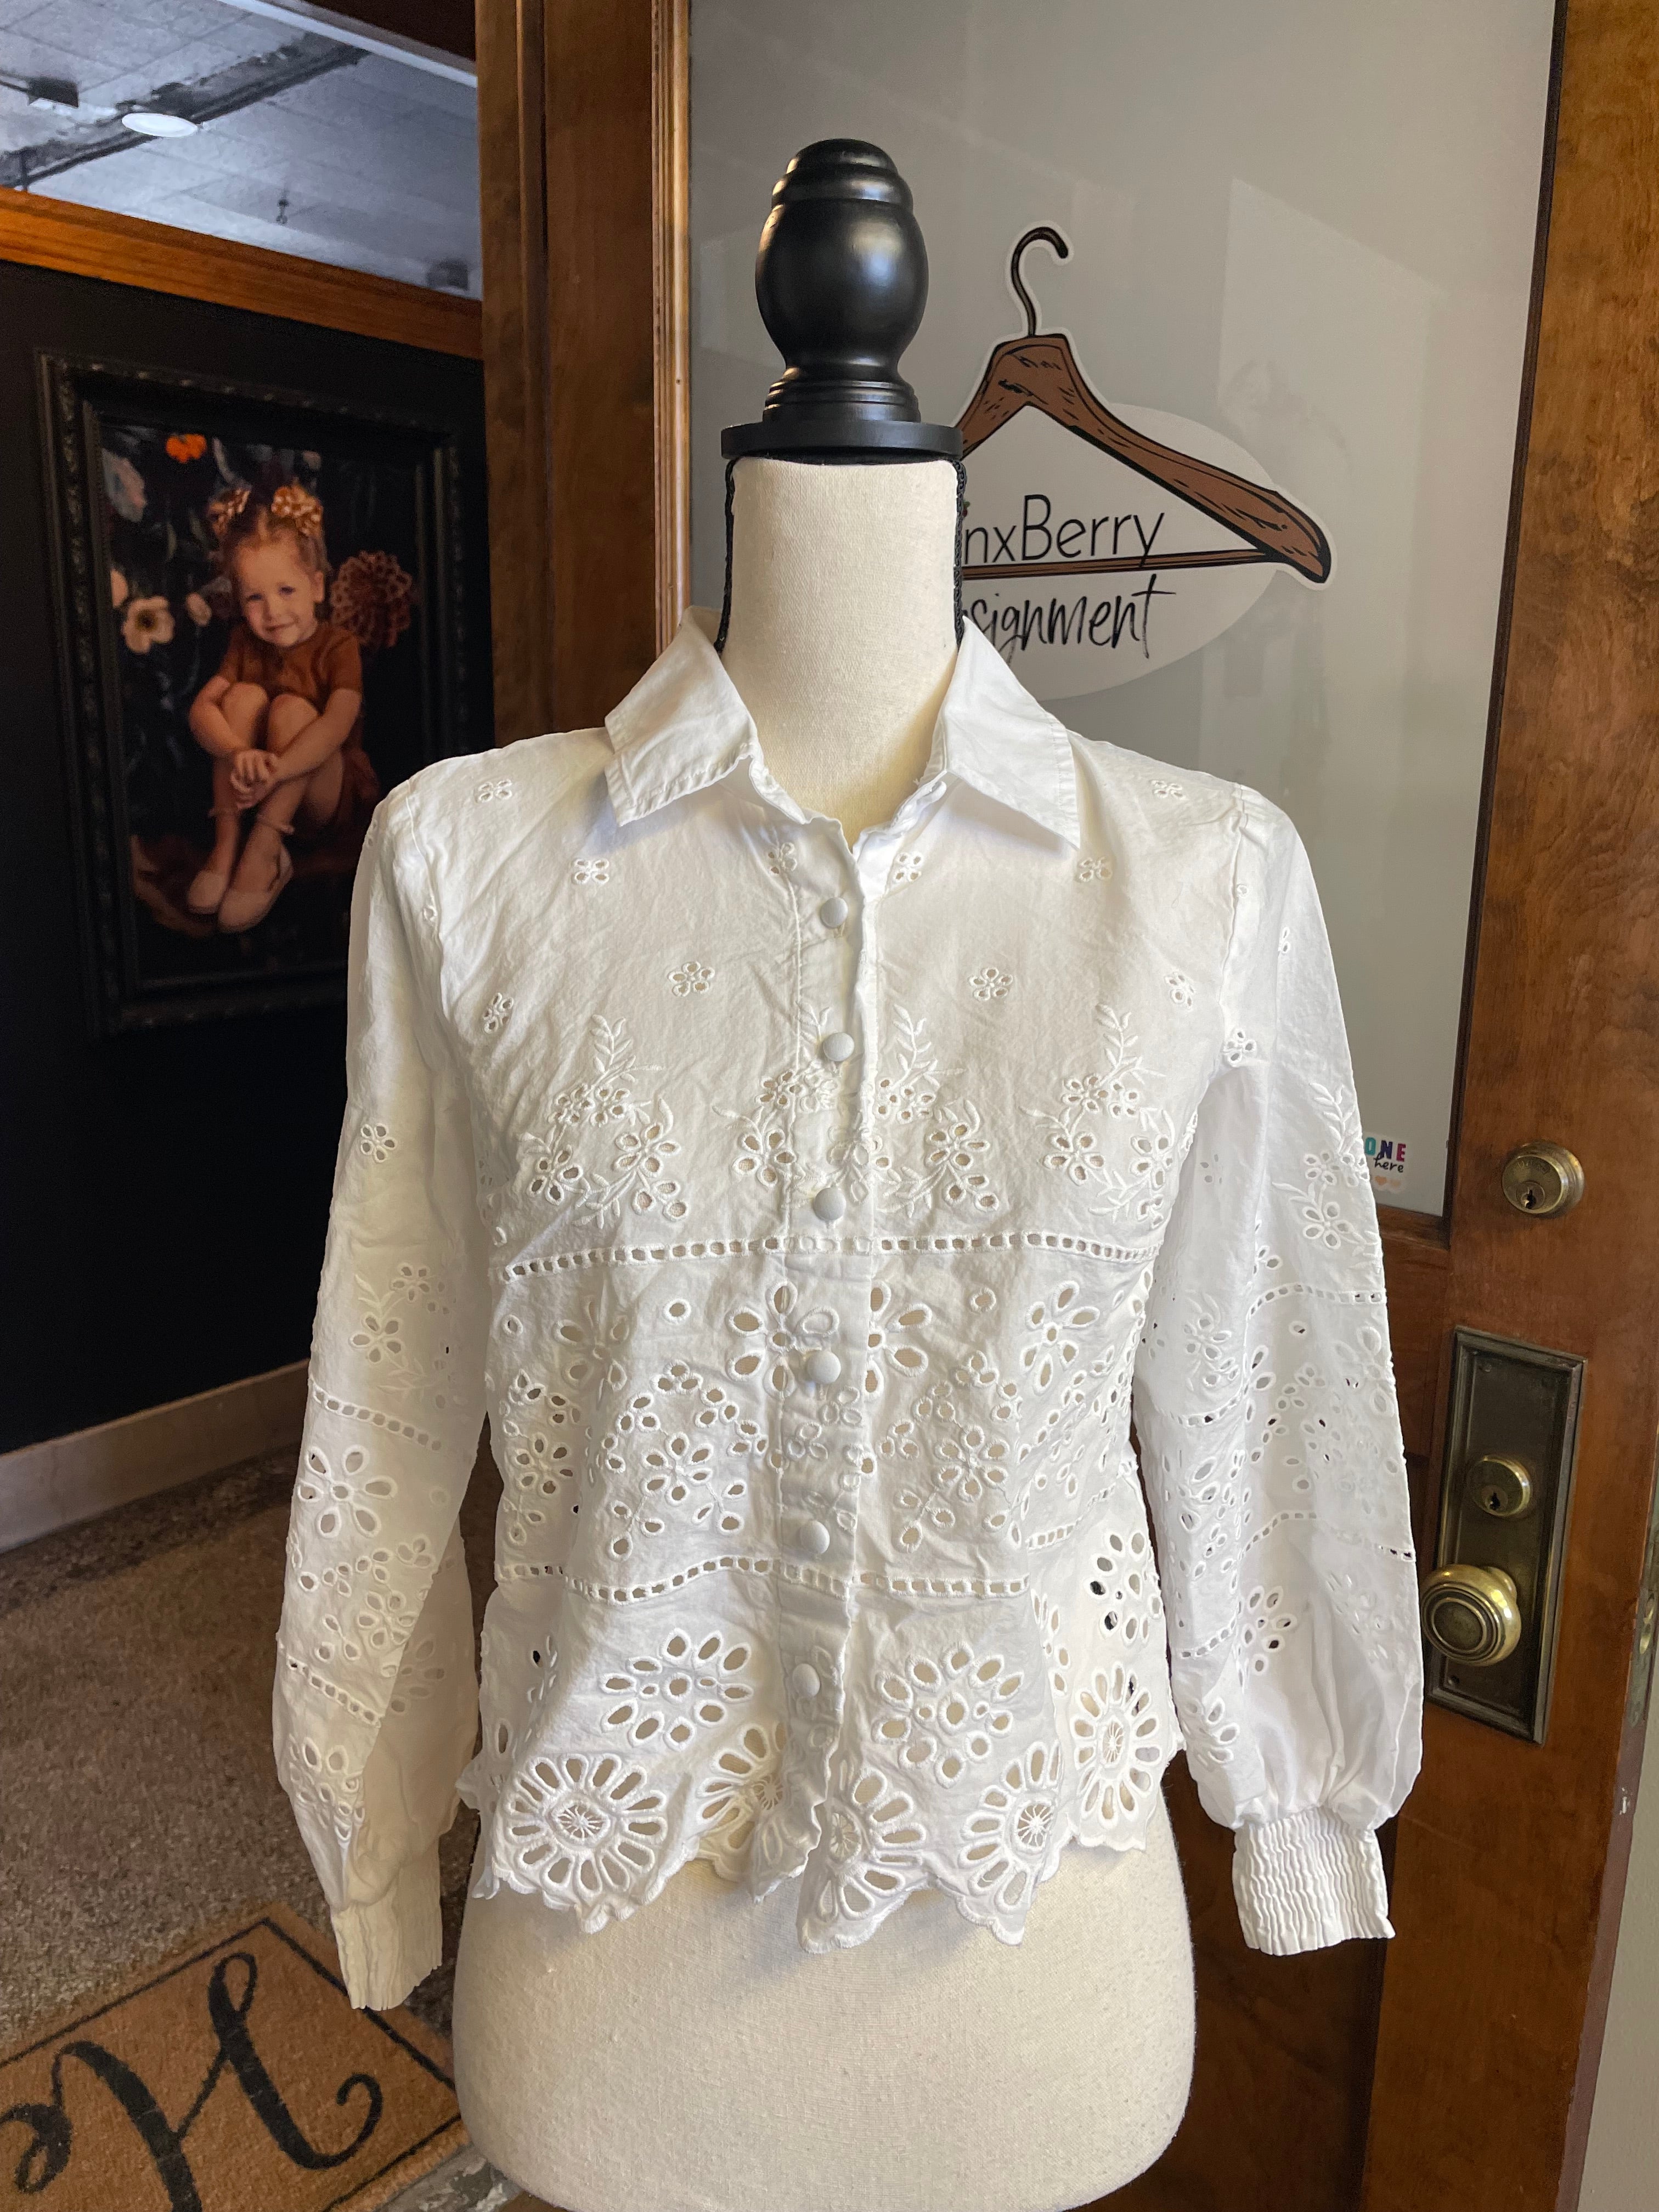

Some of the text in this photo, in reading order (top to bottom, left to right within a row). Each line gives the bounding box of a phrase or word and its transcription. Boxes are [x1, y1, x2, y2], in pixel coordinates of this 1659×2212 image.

[963, 494, 1164, 568] nxBerry
[963, 574, 1176, 665] signment
[1373, 1152, 1403, 1173] here
